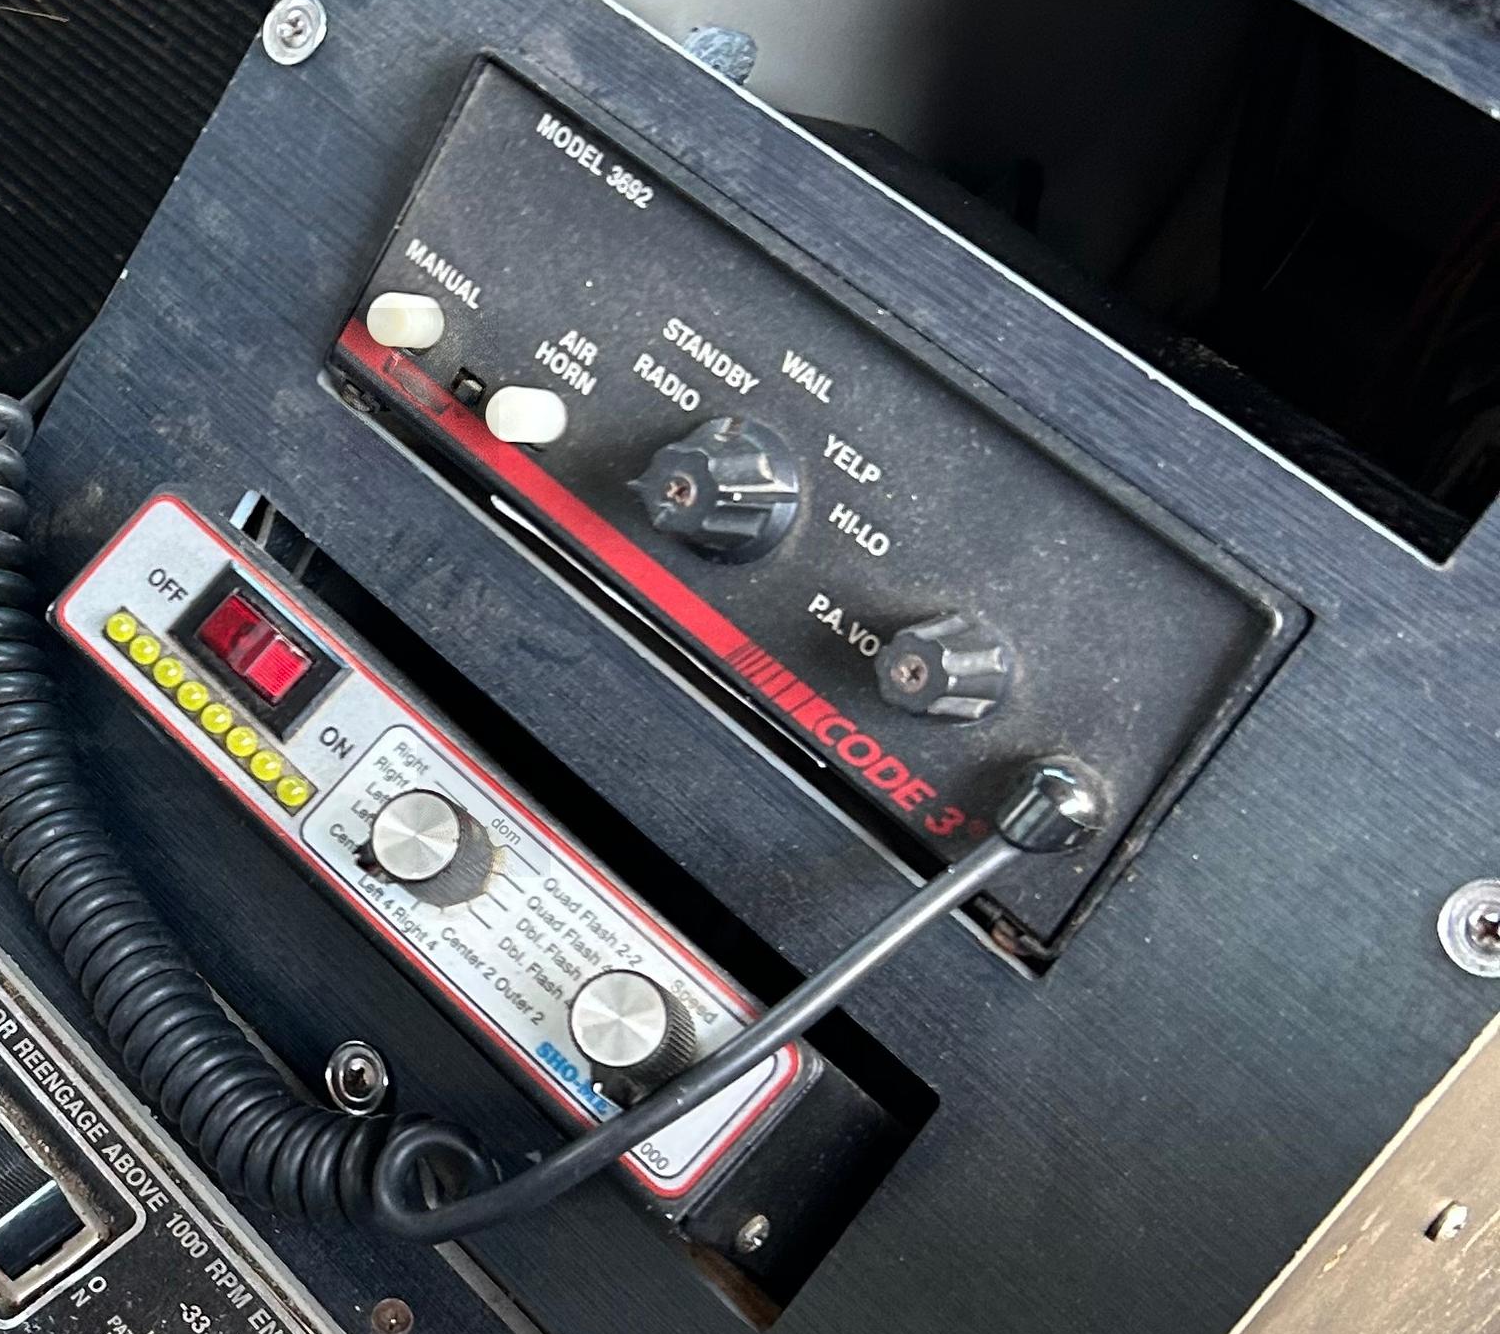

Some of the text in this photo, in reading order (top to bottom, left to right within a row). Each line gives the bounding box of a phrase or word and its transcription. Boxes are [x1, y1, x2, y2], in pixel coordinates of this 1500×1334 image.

[537, 114, 603, 175] MODEL
[406, 239, 480, 309] MANUAL
[535, 341, 596, 395] HORN
[559, 331, 597, 365] AIR
[663, 318, 759, 394] STANDBY
[633, 354, 699, 411] RADIO
[782, 351, 832, 403] WAIL
[824, 434, 881, 483] YELP
[829, 504, 889, 556] HI-LO
[148, 569, 188, 601] OFF
[808, 593, 879, 656] P.A. VO
[320, 727, 353, 759] ON
[394, 742, 430, 775] Right
[817, 713, 938, 817] CODE
[374, 756, 410, 795] Right
[327, 821, 362, 855] Cen
[350, 799, 377, 826] Lef
[358, 872, 438, 950] Left 4 Right 4
[527, 896, 566, 932] Quad
[562, 928, 601, 966] Flash
[544, 878, 643, 967] Quad Flash 2-2
[442, 927, 545, 1025] Center 2 Outer 2
[498, 937, 525, 966] Dbl.
[526, 963, 563, 1001] Flash
[516, 918, 582, 981] Dbl. Flash
[668, 977, 719, 1026] Speed
[13, 1038, 109, 1142] REENGAGE
[102, 1144, 169, 1212] ABOVE
[166, 1213, 208, 1258] 1000
[205, 1258, 253, 1309] RPM
[68, 1273, 109, 1309] ON
[180, 1303, 210, 1333] -33
